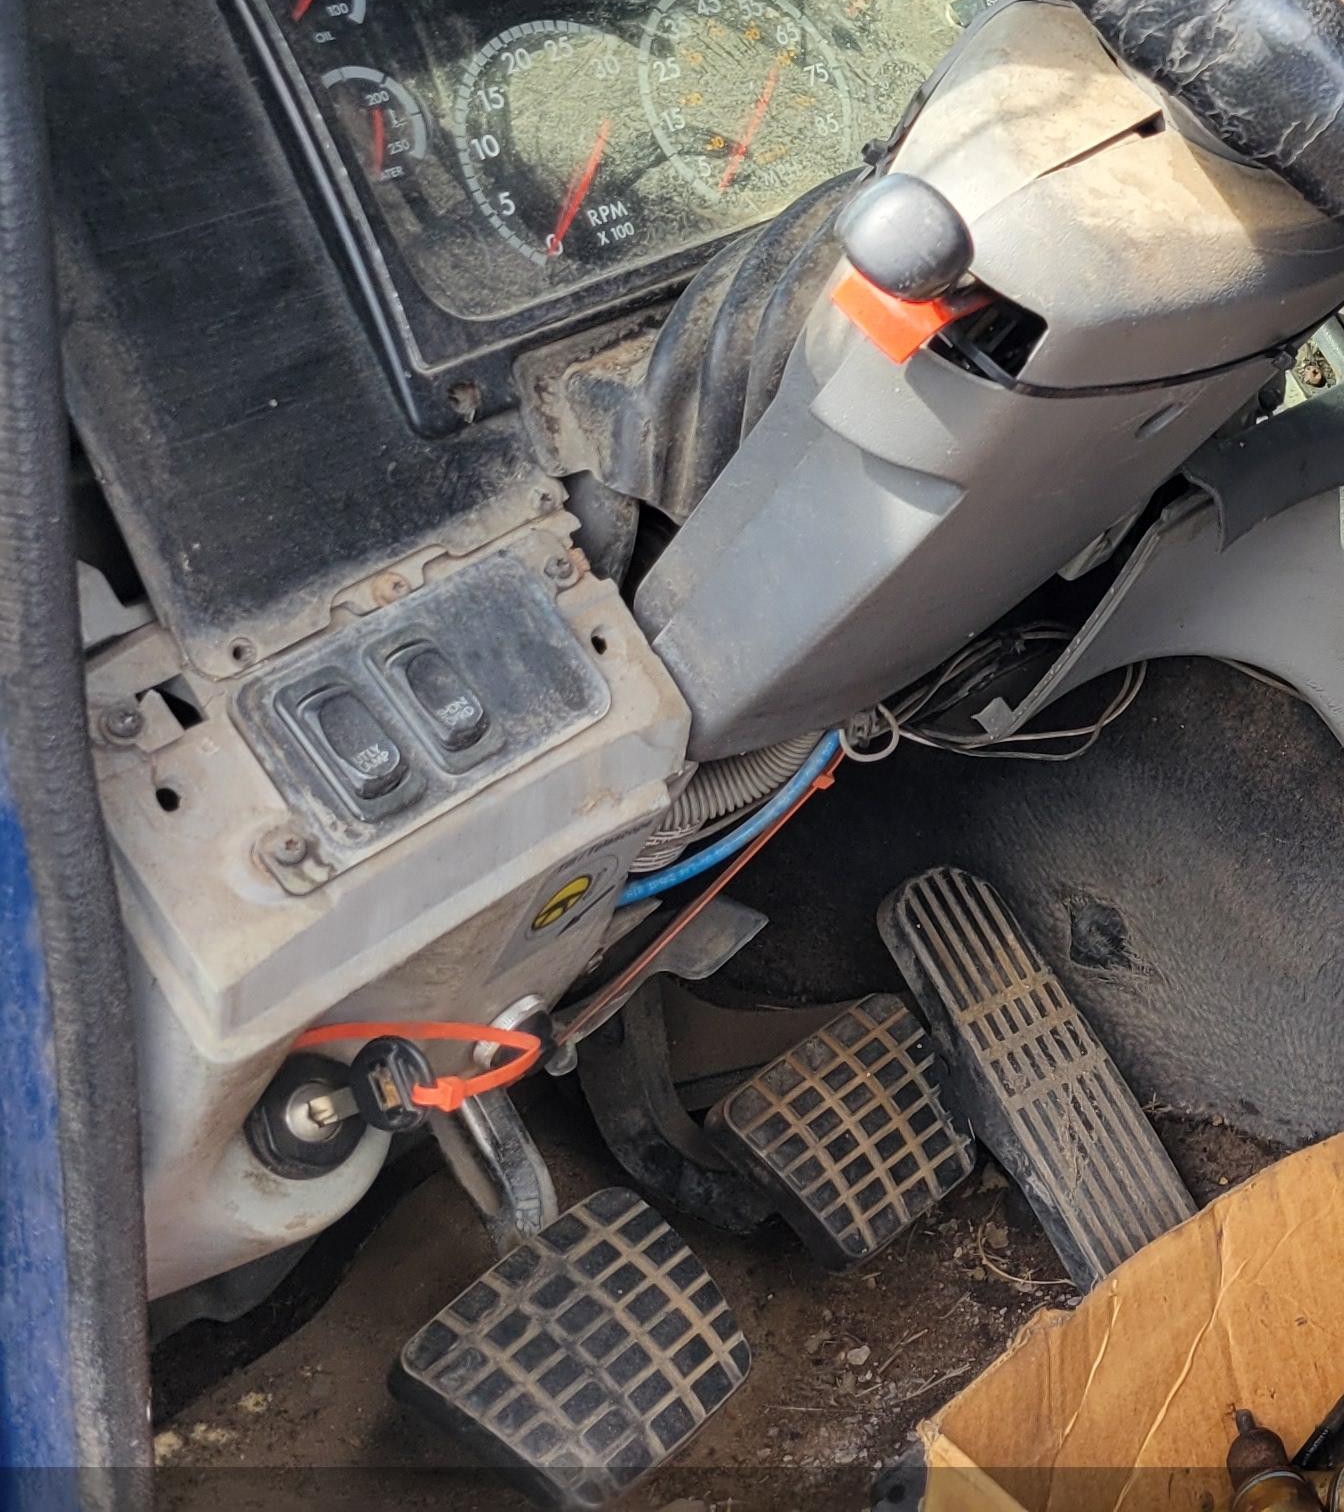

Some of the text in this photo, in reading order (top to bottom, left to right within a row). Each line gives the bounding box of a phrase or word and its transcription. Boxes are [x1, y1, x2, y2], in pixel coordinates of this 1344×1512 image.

[326, 3, 349, 16] 100
[314, 32, 336, 44] OIL
[776, 22, 801, 45] 65
[500, 48, 532, 75] 20
[543, 37, 575, 62] 25
[591, 55, 621, 80] 30
[653, 57, 681, 82] 25
[803, 62, 830, 87] 75
[366, 90, 390, 105] 200
[477, 86, 505, 113] 15
[660, 108, 686, 133] 15
[814, 113, 840, 137] 85
[387, 140, 411, 155] 250
[470, 134, 500, 161] 10
[380, 166, 405, 179] ATER
[498, 191, 516, 216] 5
[586, 199, 630, 227] RPM
[609, 222, 636, 241] 100
